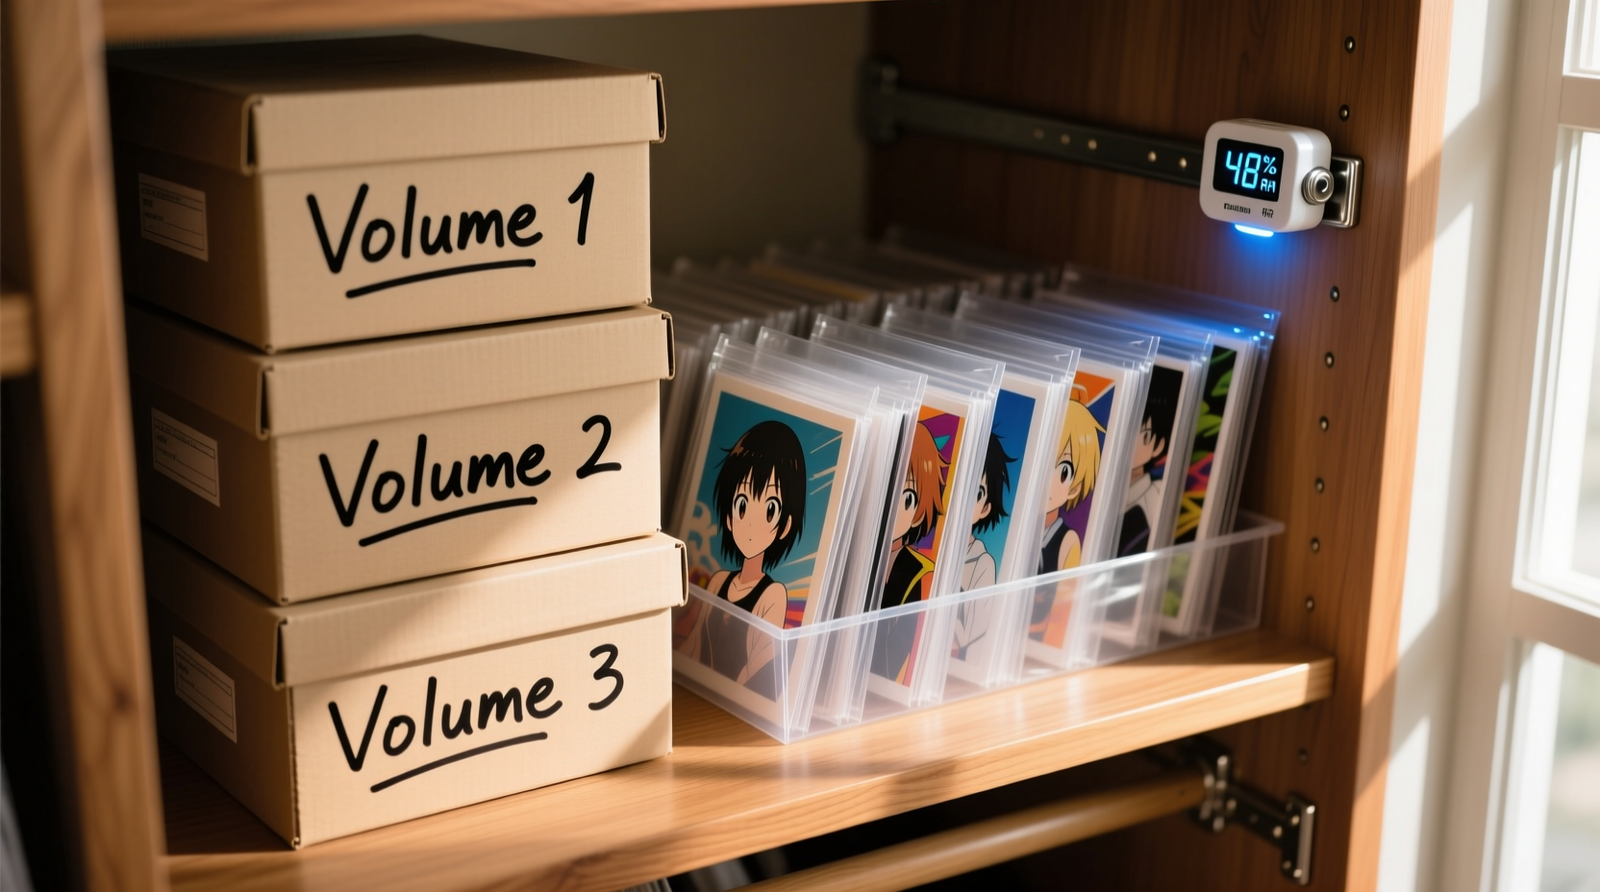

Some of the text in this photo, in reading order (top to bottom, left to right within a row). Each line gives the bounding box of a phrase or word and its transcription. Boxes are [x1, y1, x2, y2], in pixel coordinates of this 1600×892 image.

[306, 172, 595, 274] Volume 1
[318, 414, 622, 528] Volume 2
[328, 644, 624, 772] Volume 3
